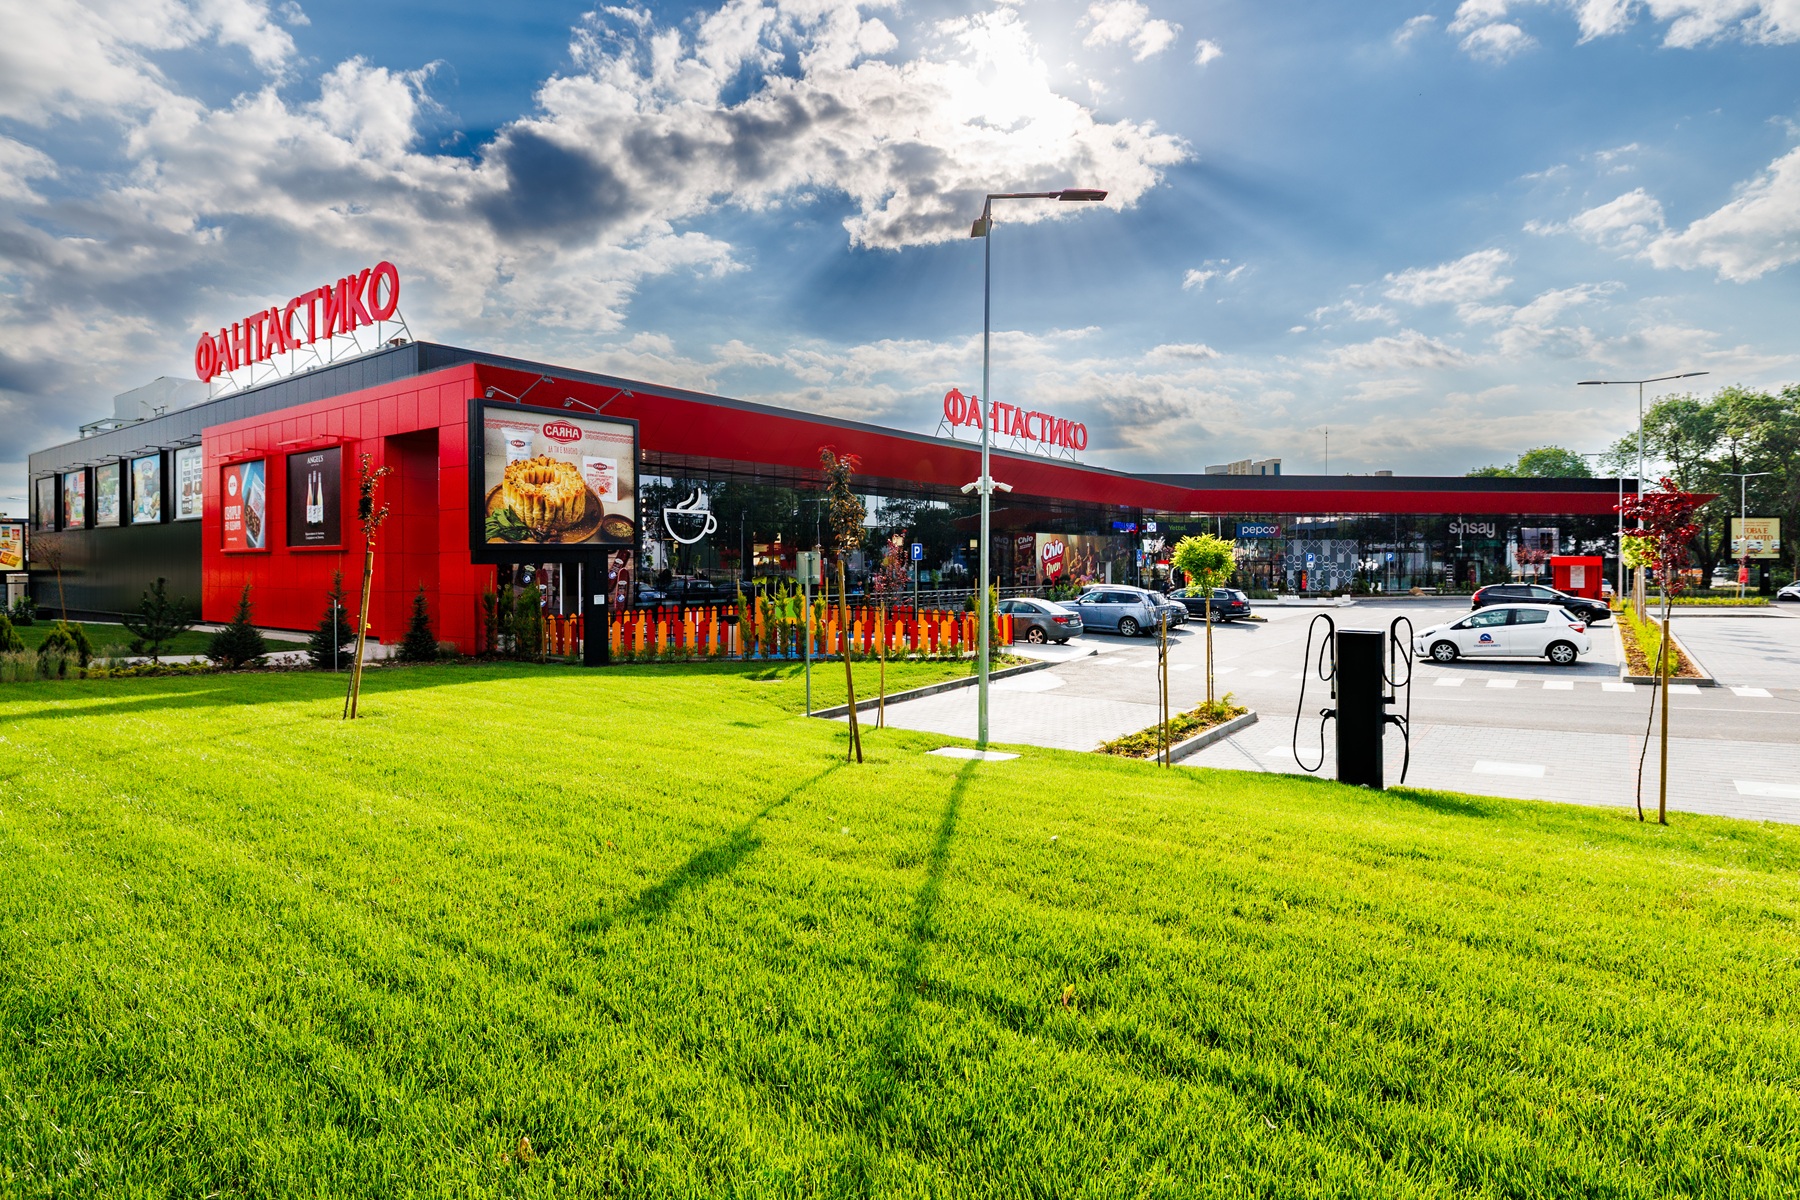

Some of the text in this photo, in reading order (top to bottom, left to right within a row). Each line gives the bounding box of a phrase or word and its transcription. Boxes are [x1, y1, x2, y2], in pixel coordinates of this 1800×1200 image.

[195, 260, 400, 383] ФАНТАСТИКО
[944, 388, 1088, 451] ФАНТАСТИКО
[545, 425, 580, 439] САЯНА
[1017, 535, 1034, 545] Chio
[1043, 539, 1064, 560] Chio
